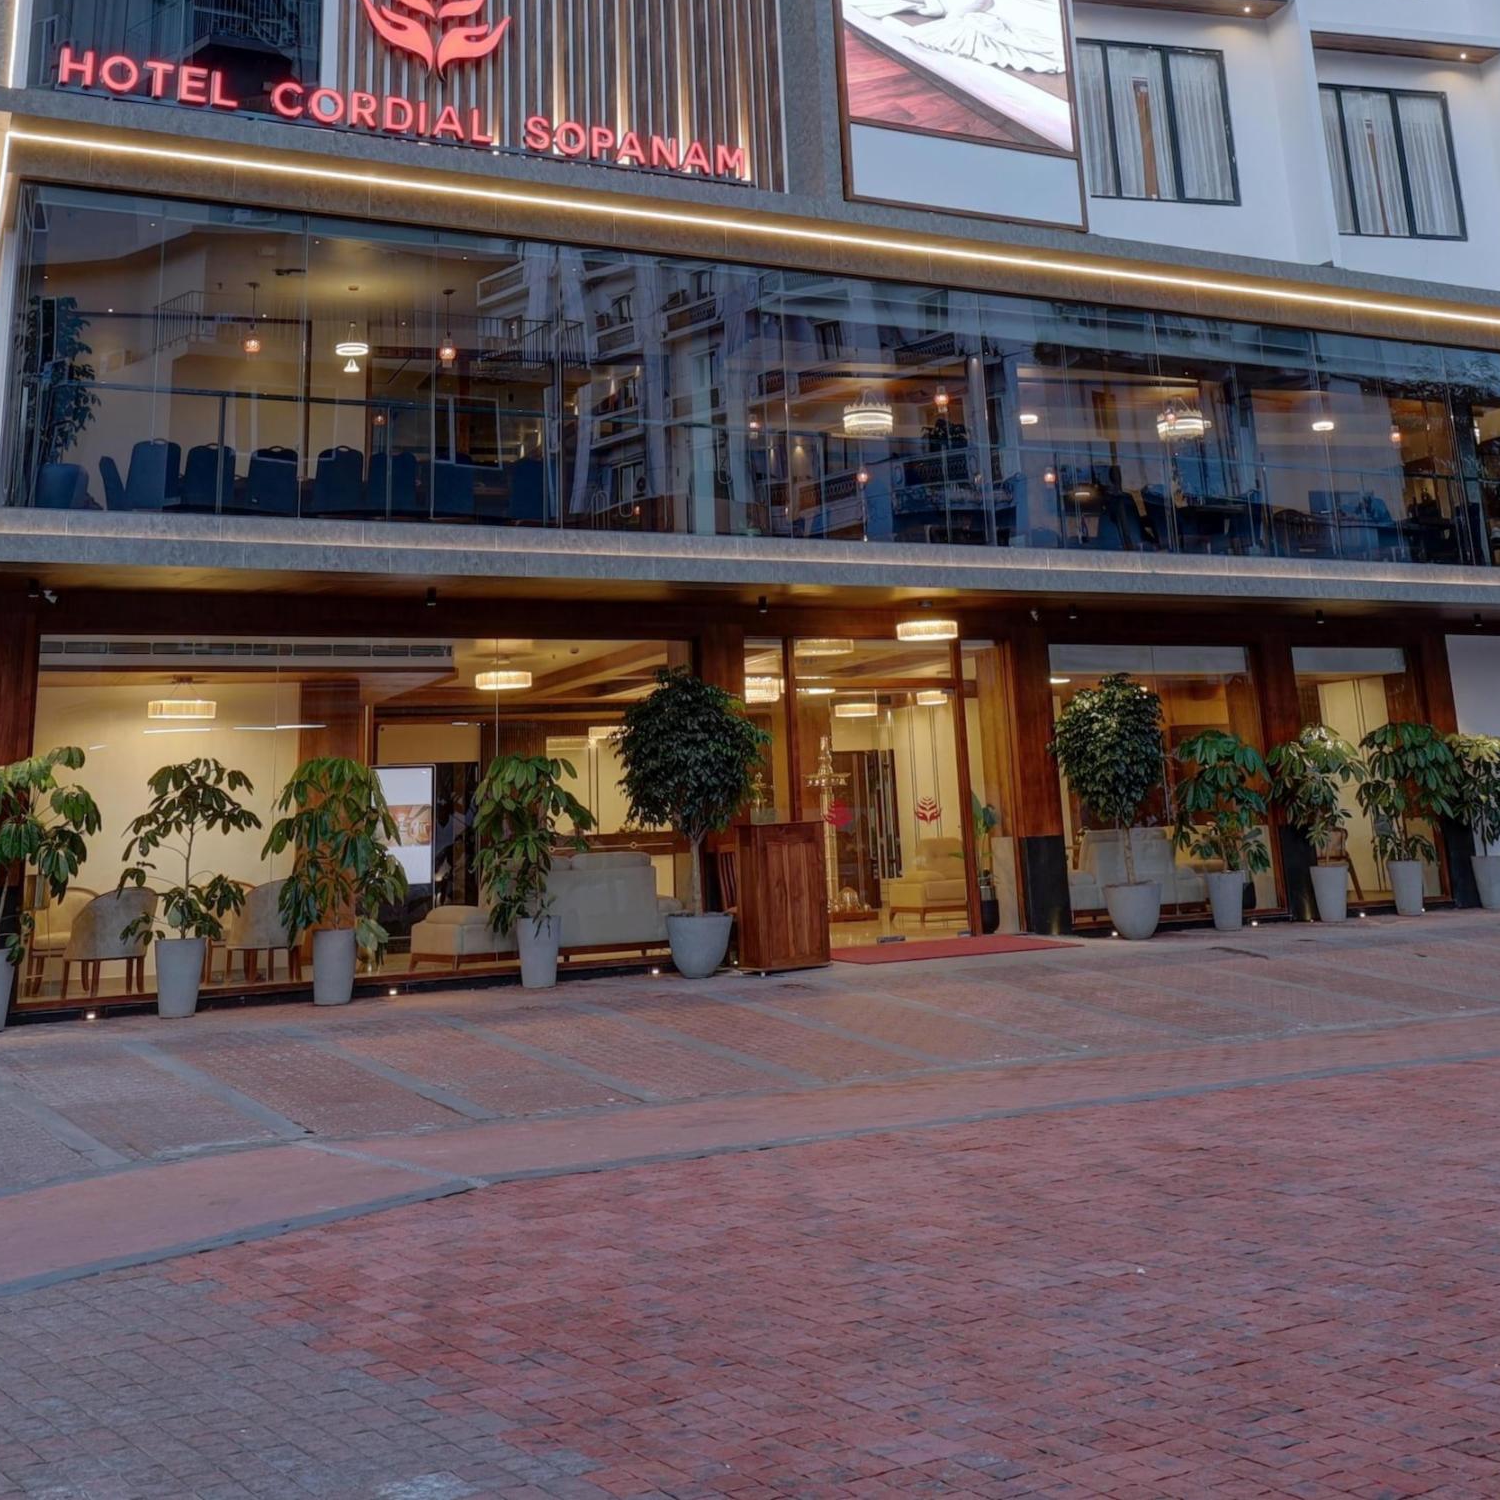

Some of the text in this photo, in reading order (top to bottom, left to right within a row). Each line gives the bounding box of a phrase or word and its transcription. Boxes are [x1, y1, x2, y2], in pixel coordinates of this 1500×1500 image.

[58, 46, 746, 179] HOTEL CORDIAL SOPANAM
